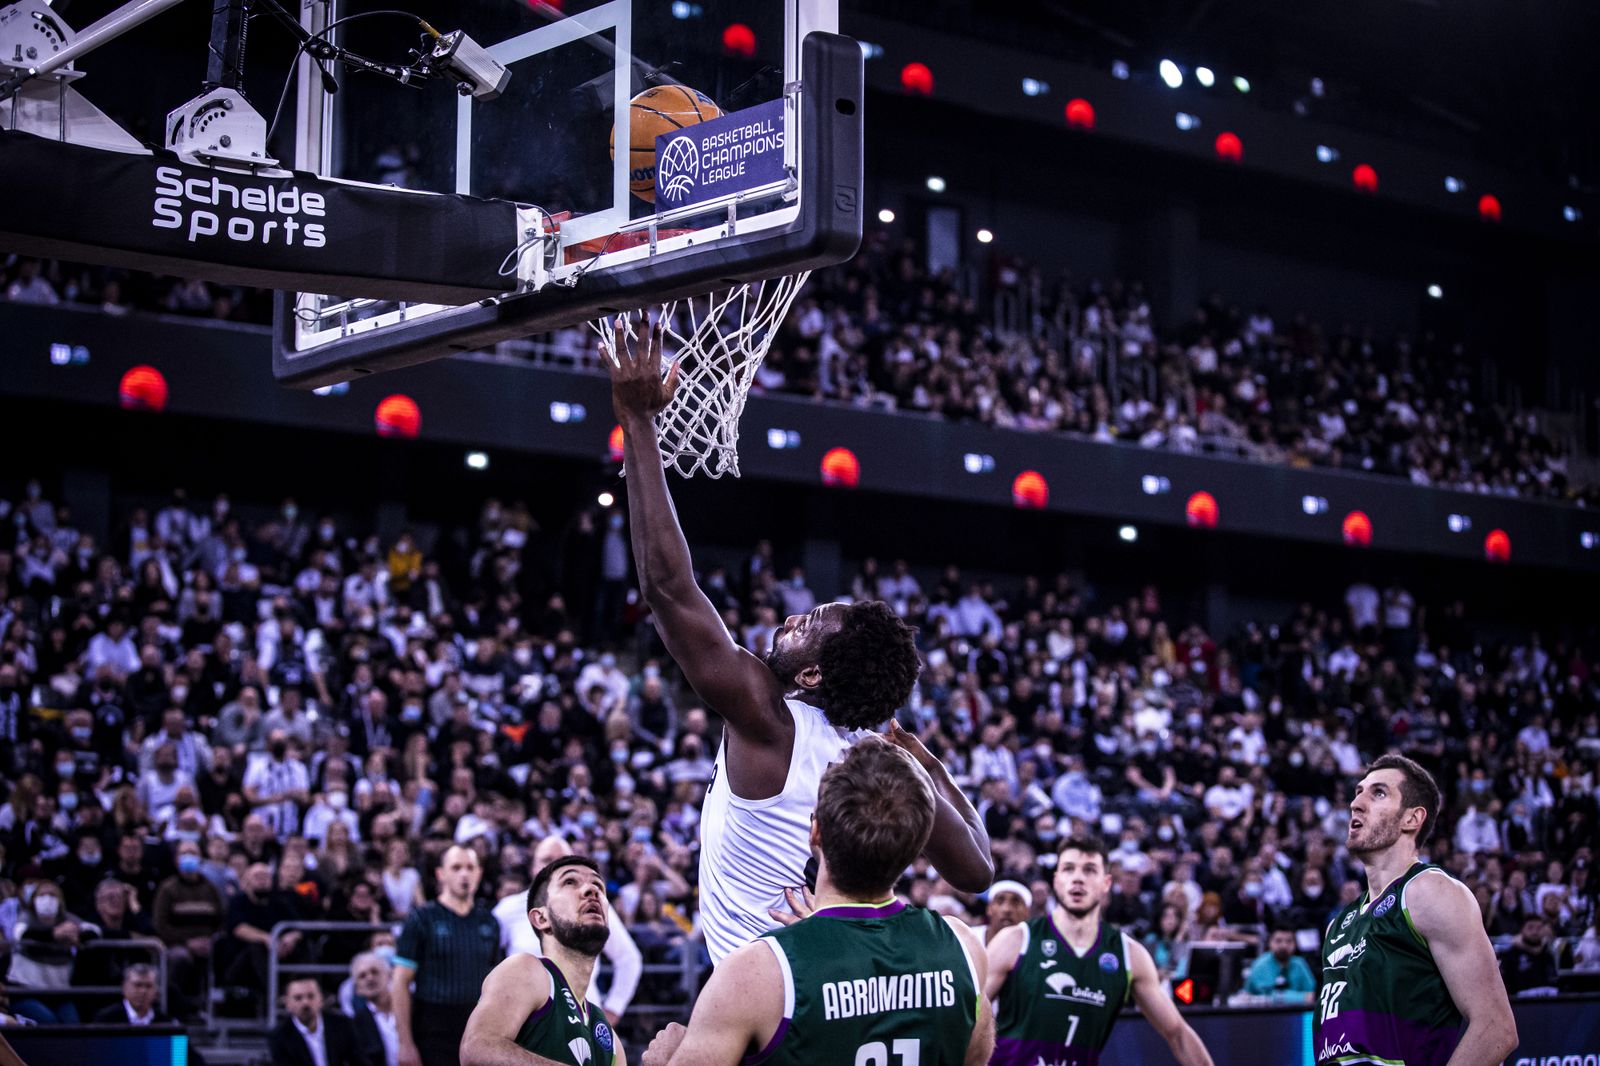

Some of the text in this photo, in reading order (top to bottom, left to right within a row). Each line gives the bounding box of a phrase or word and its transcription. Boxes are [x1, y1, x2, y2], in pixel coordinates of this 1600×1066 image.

[702, 119, 775, 151] BASKETBALL
[702, 132, 784, 169] CHAMPIONS
[155, 166, 326, 217] Schelde
[702, 161, 746, 186] LEAGUE
[152, 197, 326, 248] Sports
[822, 969, 955, 1020] ABROMAITIS
[1065, 1015, 1079, 1047] 7
